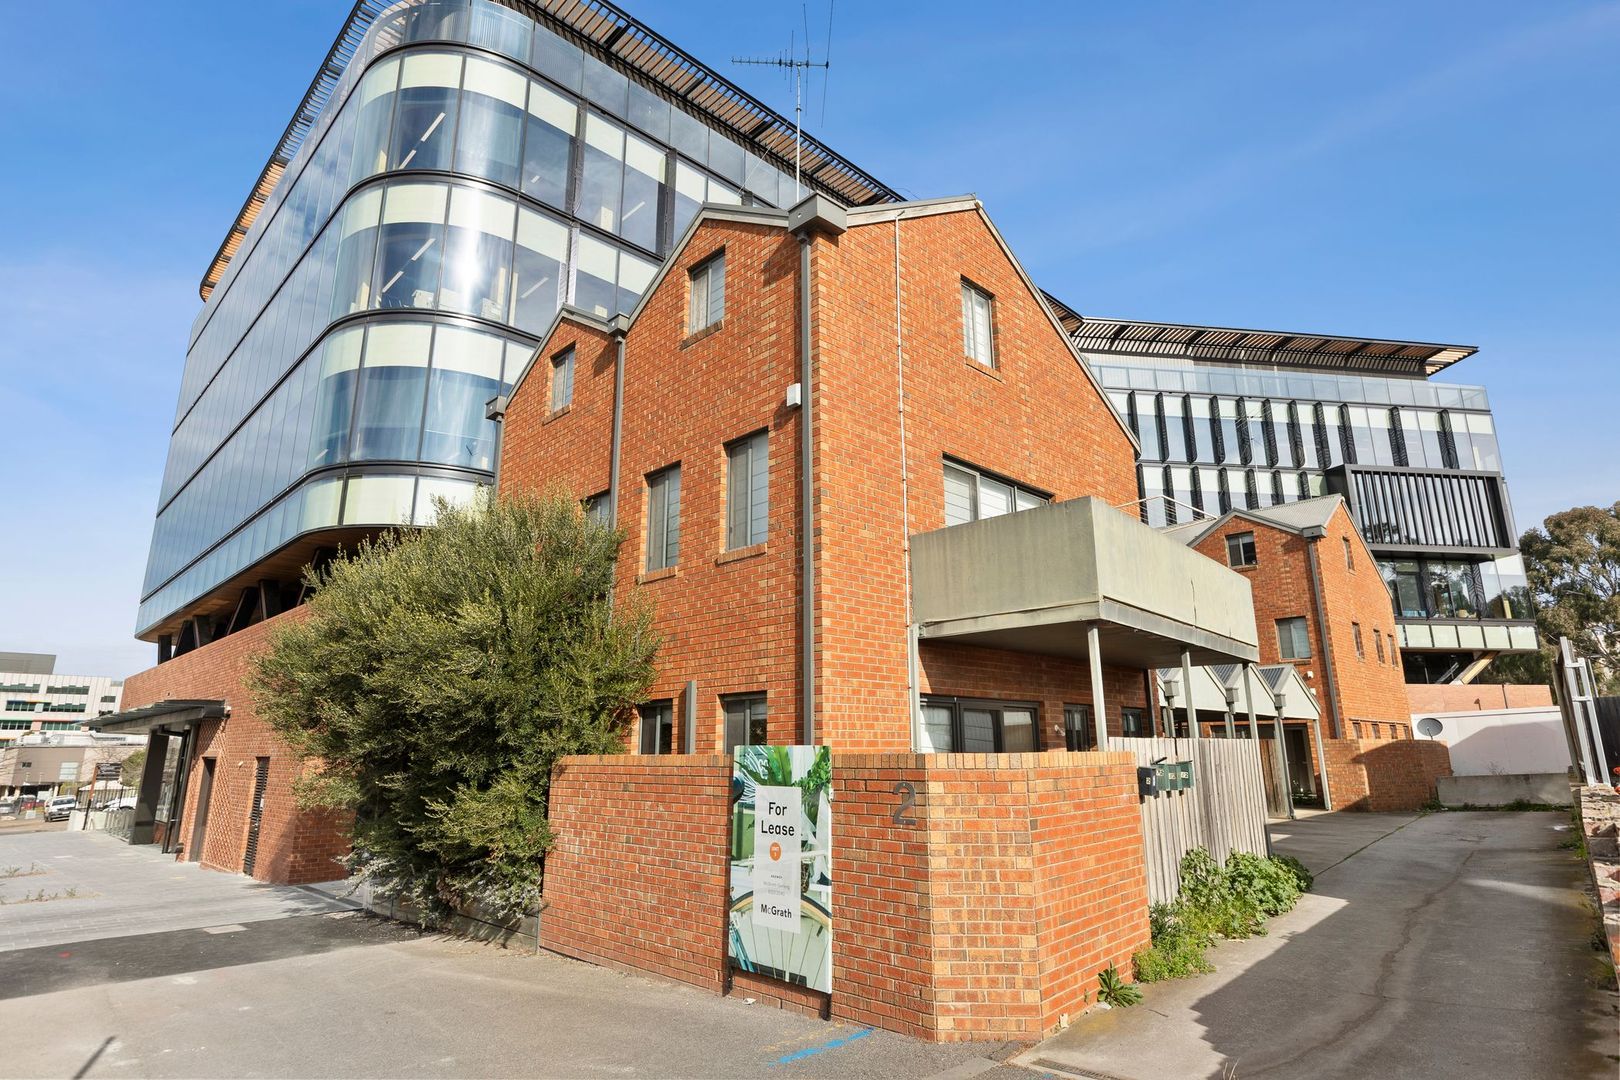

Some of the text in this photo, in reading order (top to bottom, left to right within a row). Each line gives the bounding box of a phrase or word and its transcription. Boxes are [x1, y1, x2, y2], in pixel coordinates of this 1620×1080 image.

[768, 802, 788, 816] For
[893, 781, 916, 825] 2
[761, 820, 795, 836] Lease
[760, 904, 792, 918] McGrath
